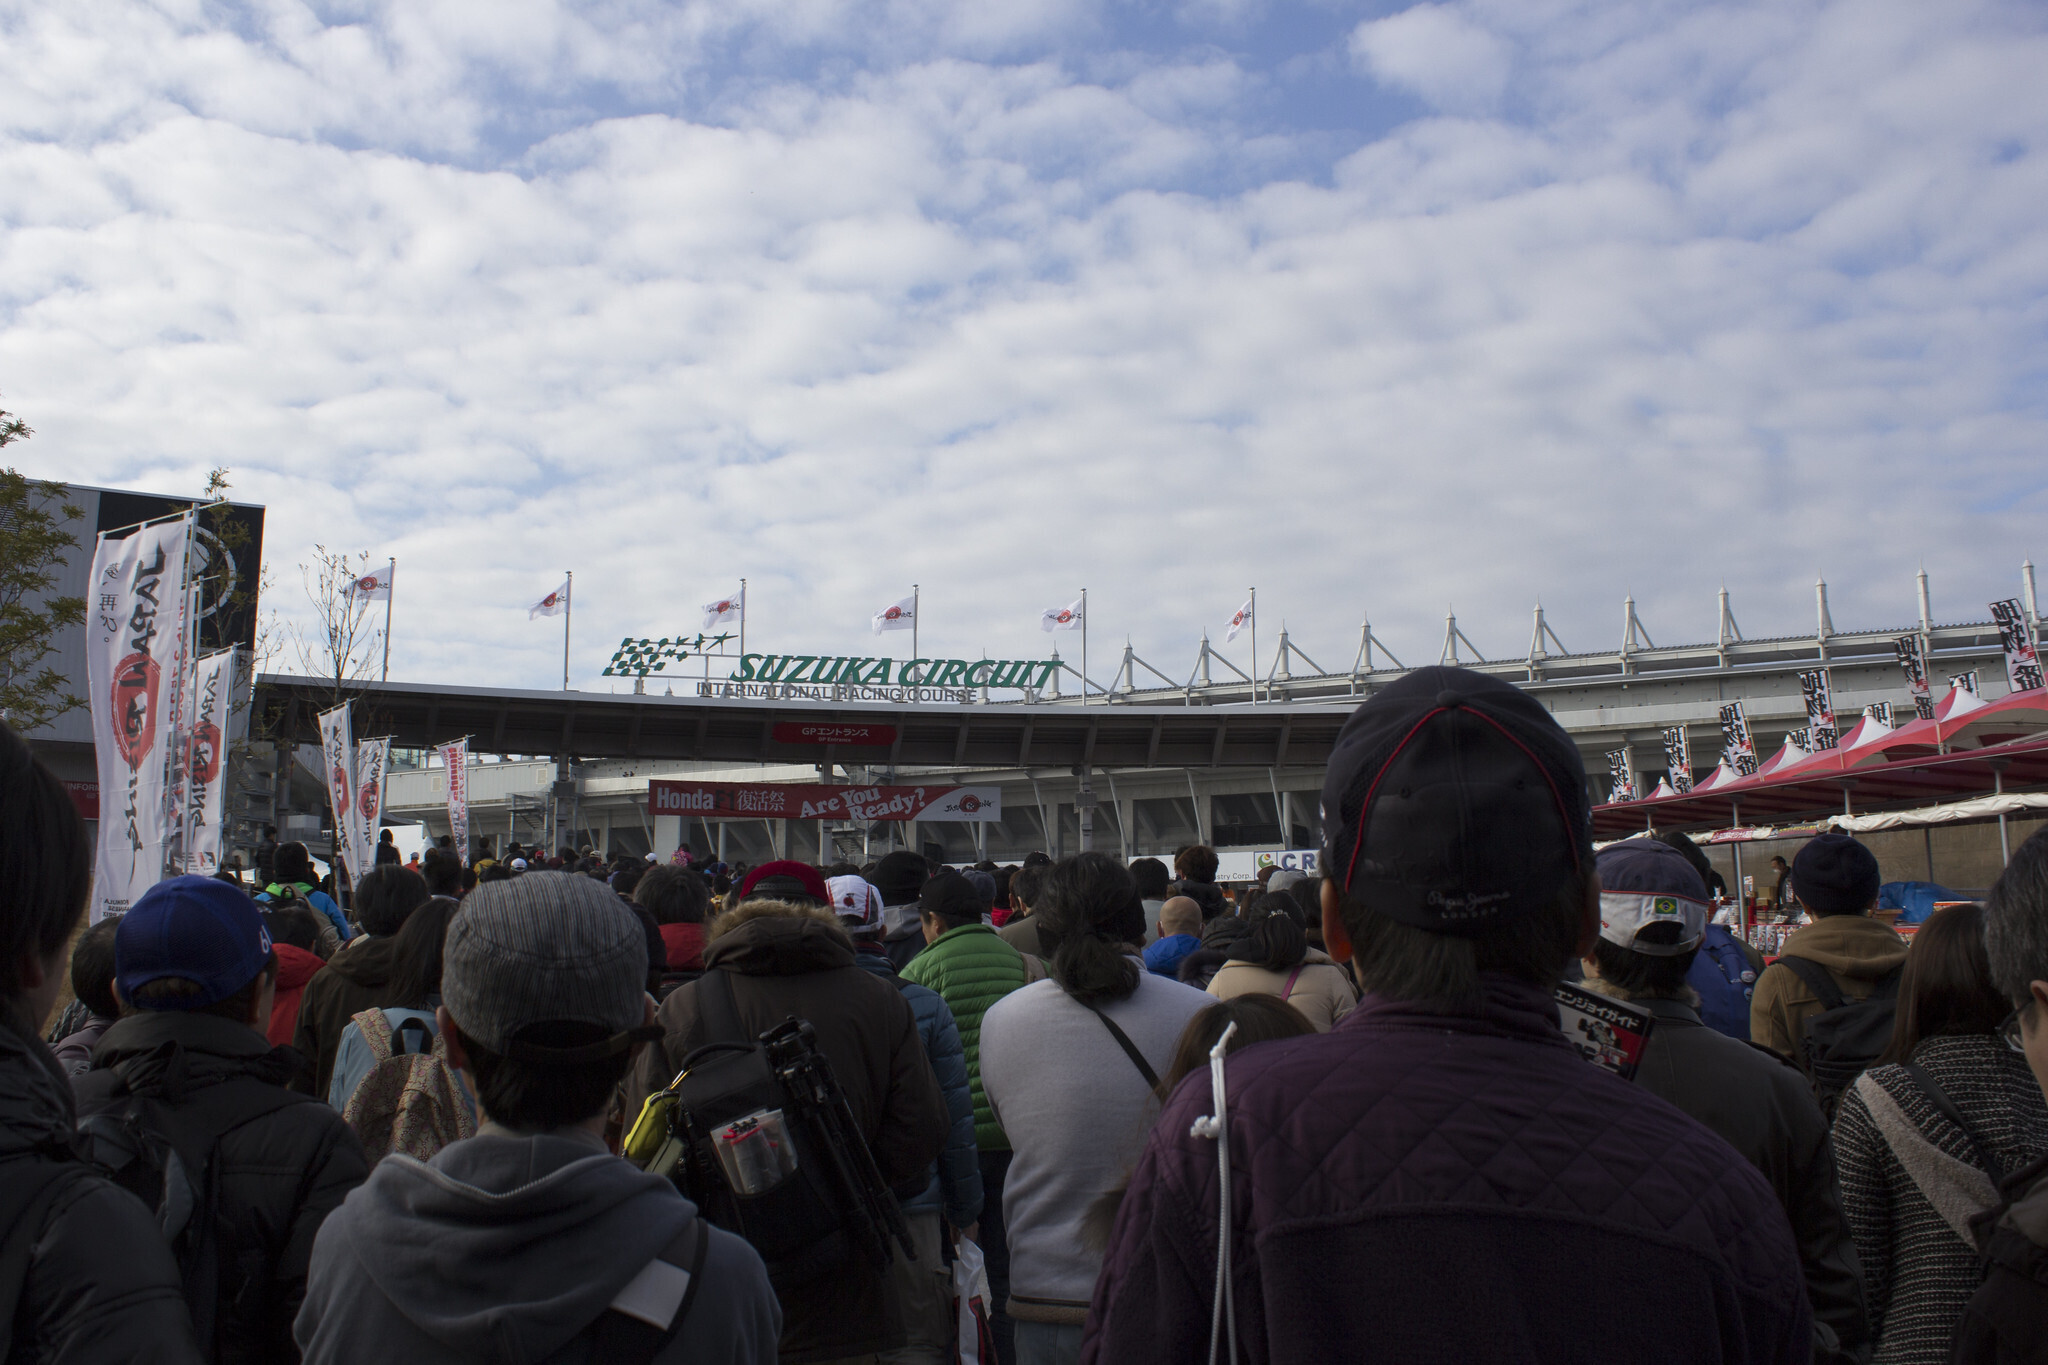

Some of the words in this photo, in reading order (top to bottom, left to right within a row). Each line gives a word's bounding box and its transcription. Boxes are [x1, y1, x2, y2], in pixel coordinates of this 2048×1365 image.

[730, 653, 893, 686] SUZUKA
[898, 658, 1064, 688] CIRCUIT
[696, 682, 832, 700] INTERNATIONAL
[840, 687, 902, 701] RACING
[908, 689, 977, 703] COURSE
[801, 727, 869, 737] GPエントランス
[657, 786, 714, 810] Honda
[714, 790, 735, 811] F1
[737, 789, 785, 812] 復活祭
[800, 795, 840, 819] Are
[840, 788, 882, 808] You
[848, 787, 926, 821] Ready?
[1553, 988, 1640, 1029] エンジョイガイド
